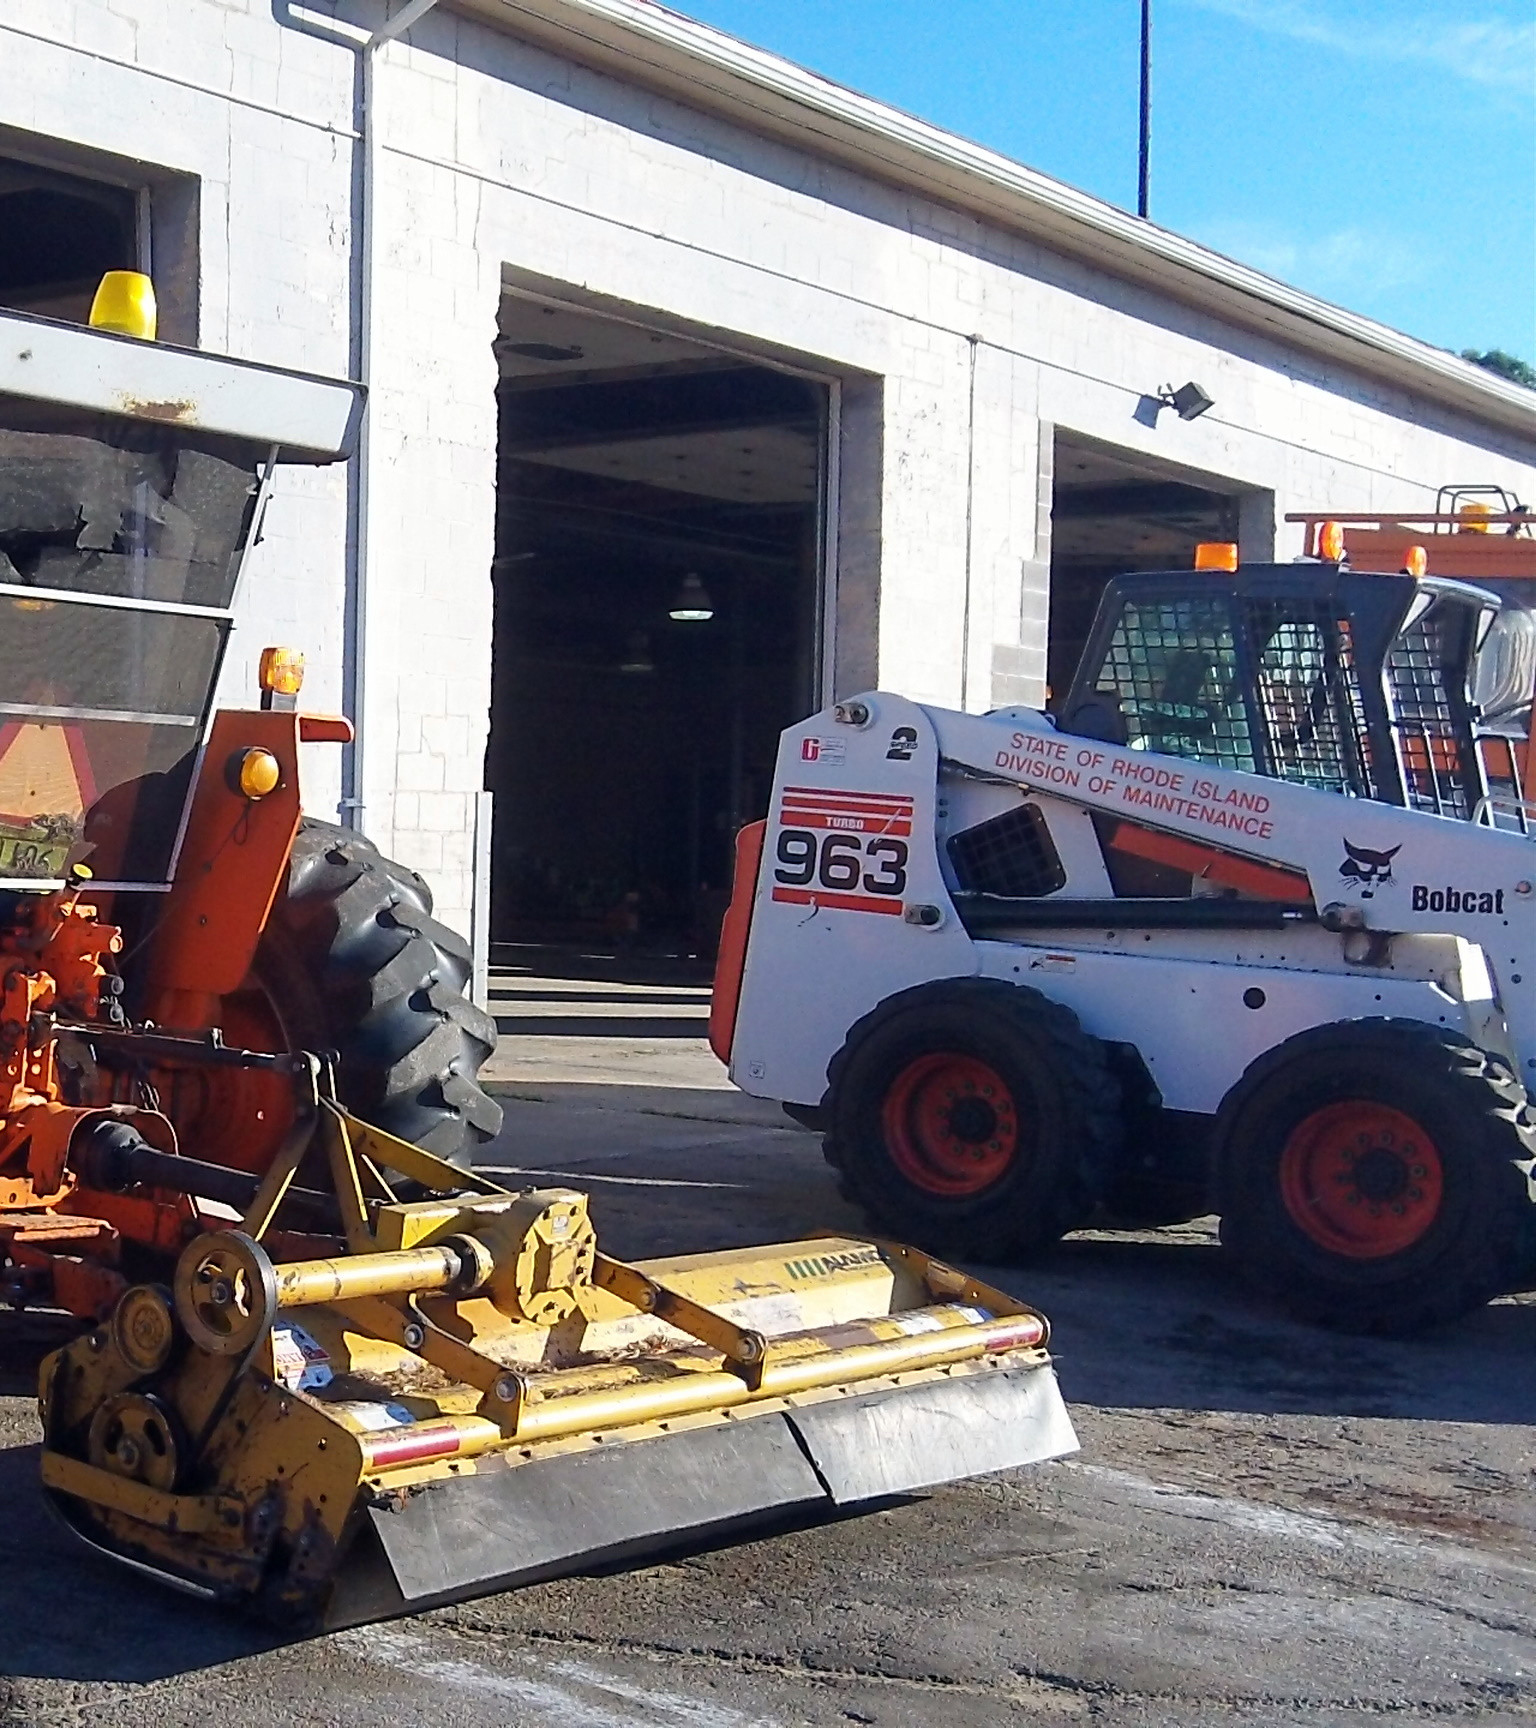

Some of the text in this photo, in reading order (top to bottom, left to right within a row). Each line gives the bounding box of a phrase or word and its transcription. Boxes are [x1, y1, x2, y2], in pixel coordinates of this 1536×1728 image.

[995, 751, 1274, 839] DIVISION OF MAINTENANCE
[1010, 732, 1270, 814] STATE OF RHODE ISLAND
[825, 816, 864, 830] TURBO
[774, 829, 908, 896] 963
[1412, 885, 1504, 915] Bobcat
